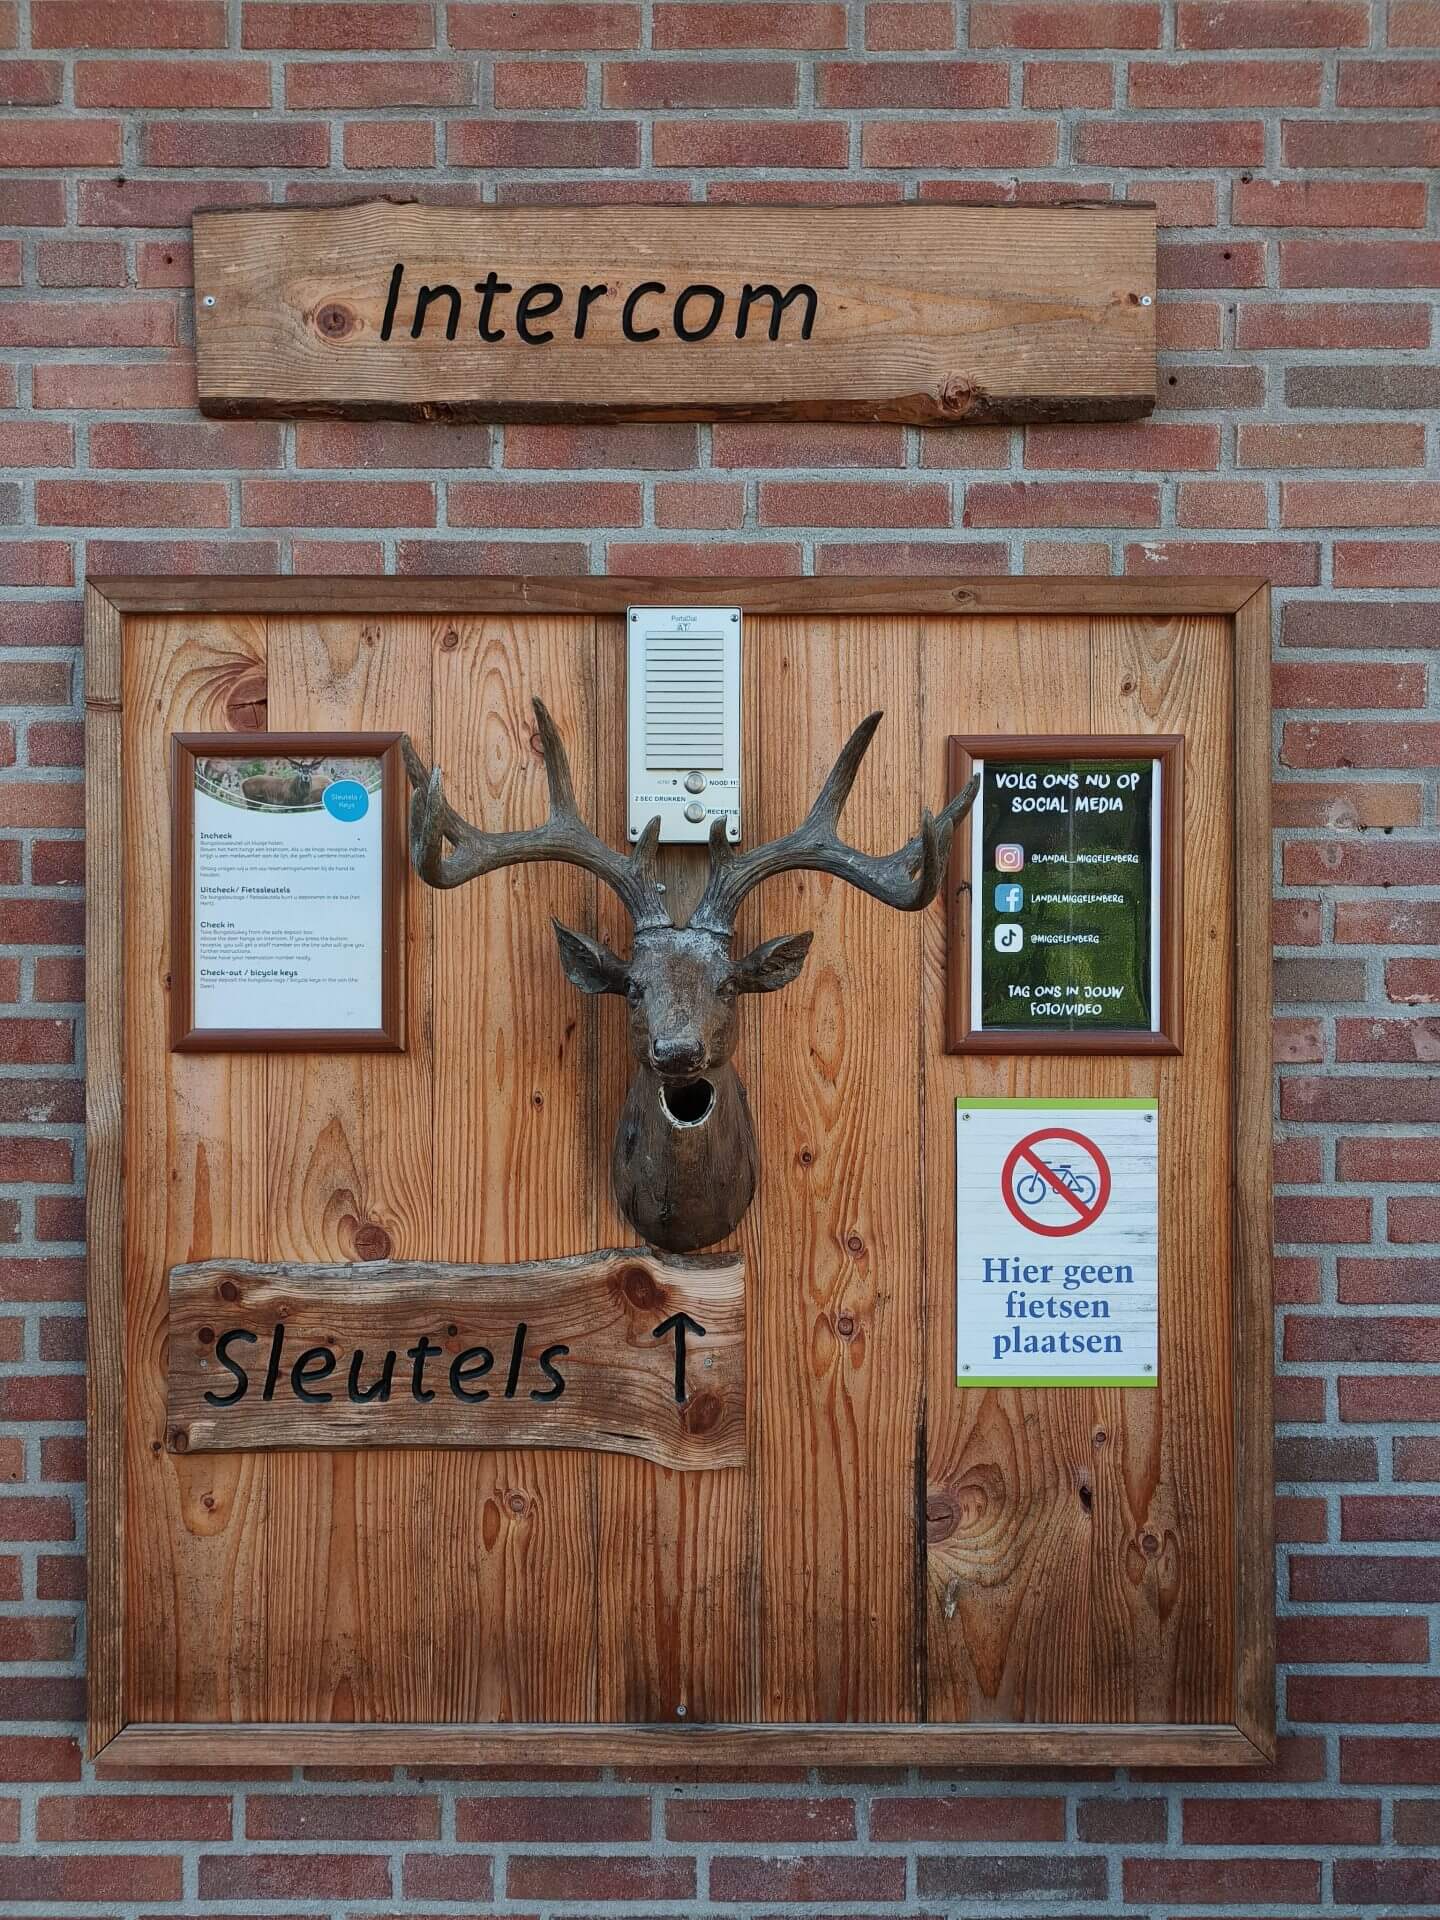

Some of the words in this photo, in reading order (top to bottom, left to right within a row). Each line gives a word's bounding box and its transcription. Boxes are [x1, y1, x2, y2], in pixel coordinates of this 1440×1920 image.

[380, 263, 818, 345] Intercom
[995, 772, 1037, 790] VOLG
[1042, 773, 1079, 790] ONS
[1085, 774, 1111, 789] NU
[1116, 772, 1140, 791] OP
[1011, 796, 1069, 813] SOCIAL
[1074, 796, 1123, 814] MEDIA
[1031, 853, 1139, 864] @LANDAL_MIGGELENBERG
[241, 886, 291, 894] Fietssleutels
[1031, 894, 1124, 904] LANDALMIGGELENBERG
[200, 921, 225, 929] Check
[227, 921, 235, 929] in
[1030, 934, 1100, 944] @MIGGELENBERG
[250, 969, 278, 978] bicycle
[280, 969, 299, 978] keys
[1008, 984, 1030, 998] TAG
[1034, 985, 1062, 998] ONS
[1066, 986, 1080, 997] IN
[1083, 985, 1125, 999] JOUW
[1030, 1002, 1103, 1017] FOTO/VIDEO
[982, 1256, 1054, 1284] Hier
[1062, 1265, 1134, 1291] geen
[1005, 1290, 1111, 1319] fietsen
[992, 1325, 1124, 1360] plaatsen
[202, 1322, 570, 1408] Sleutels
